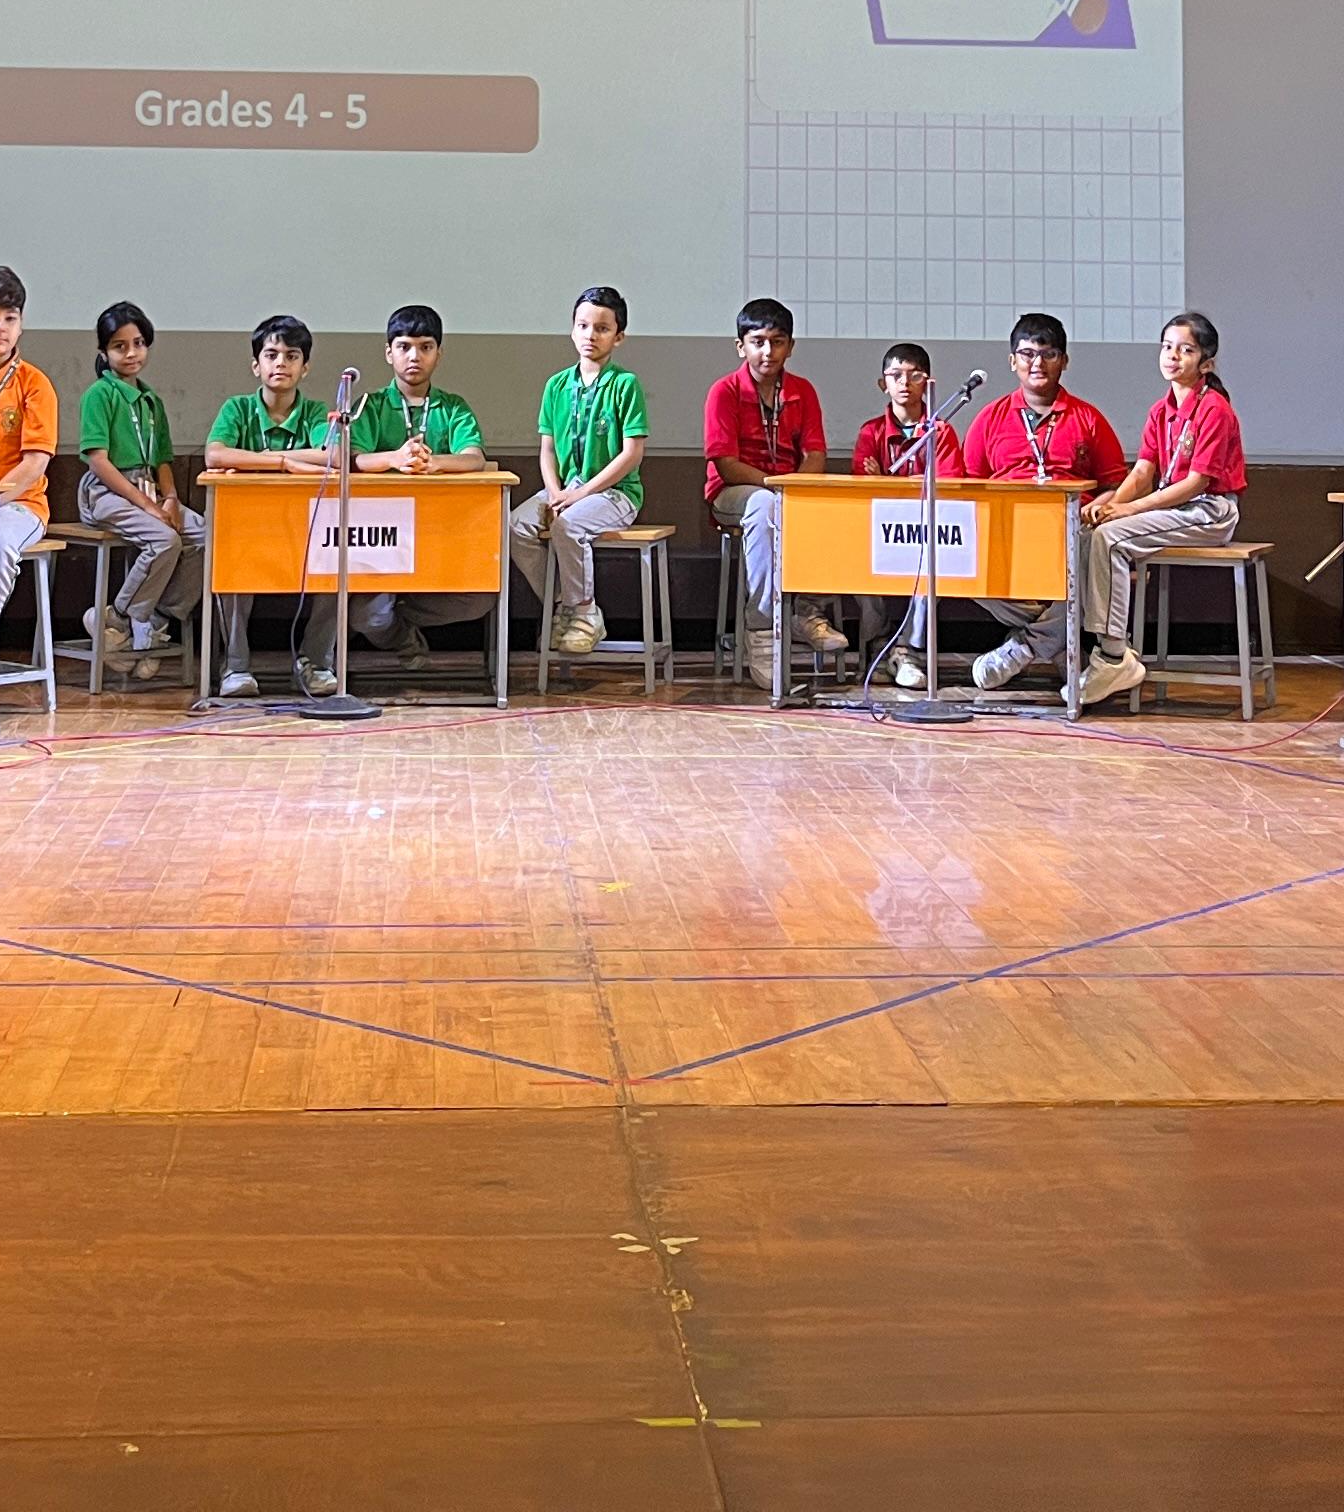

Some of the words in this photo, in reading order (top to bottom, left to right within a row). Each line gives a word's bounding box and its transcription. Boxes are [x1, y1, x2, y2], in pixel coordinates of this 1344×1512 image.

[134, 88, 273, 128] Grades
[284, 93, 309, 128] 4
[345, 93, 367, 130] 5
